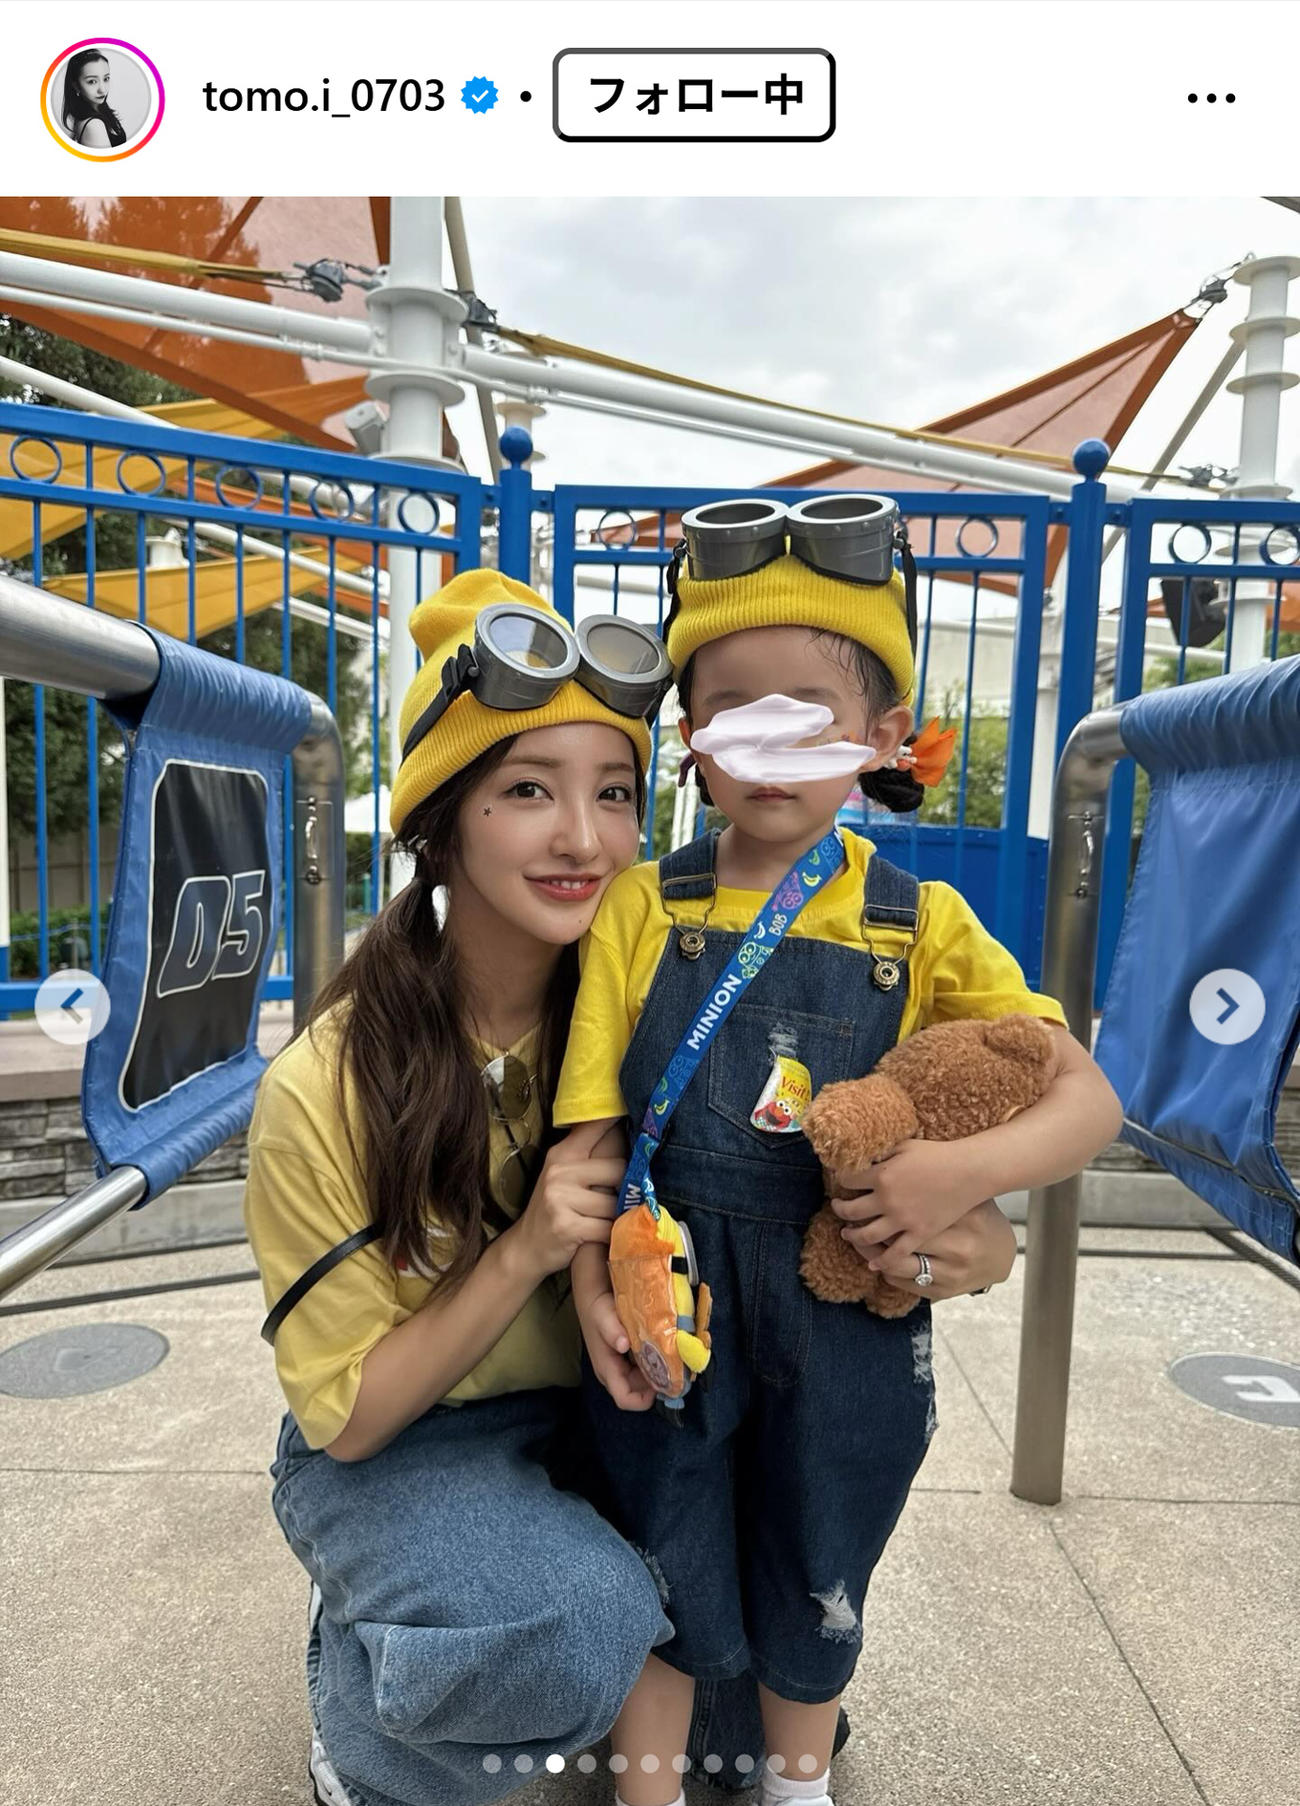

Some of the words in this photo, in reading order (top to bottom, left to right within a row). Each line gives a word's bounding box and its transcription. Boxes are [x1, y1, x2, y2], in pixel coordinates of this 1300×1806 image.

[157, 869, 266, 998] 05
[769, 913, 788, 936] BOB
[686, 973, 743, 1051] MINION
